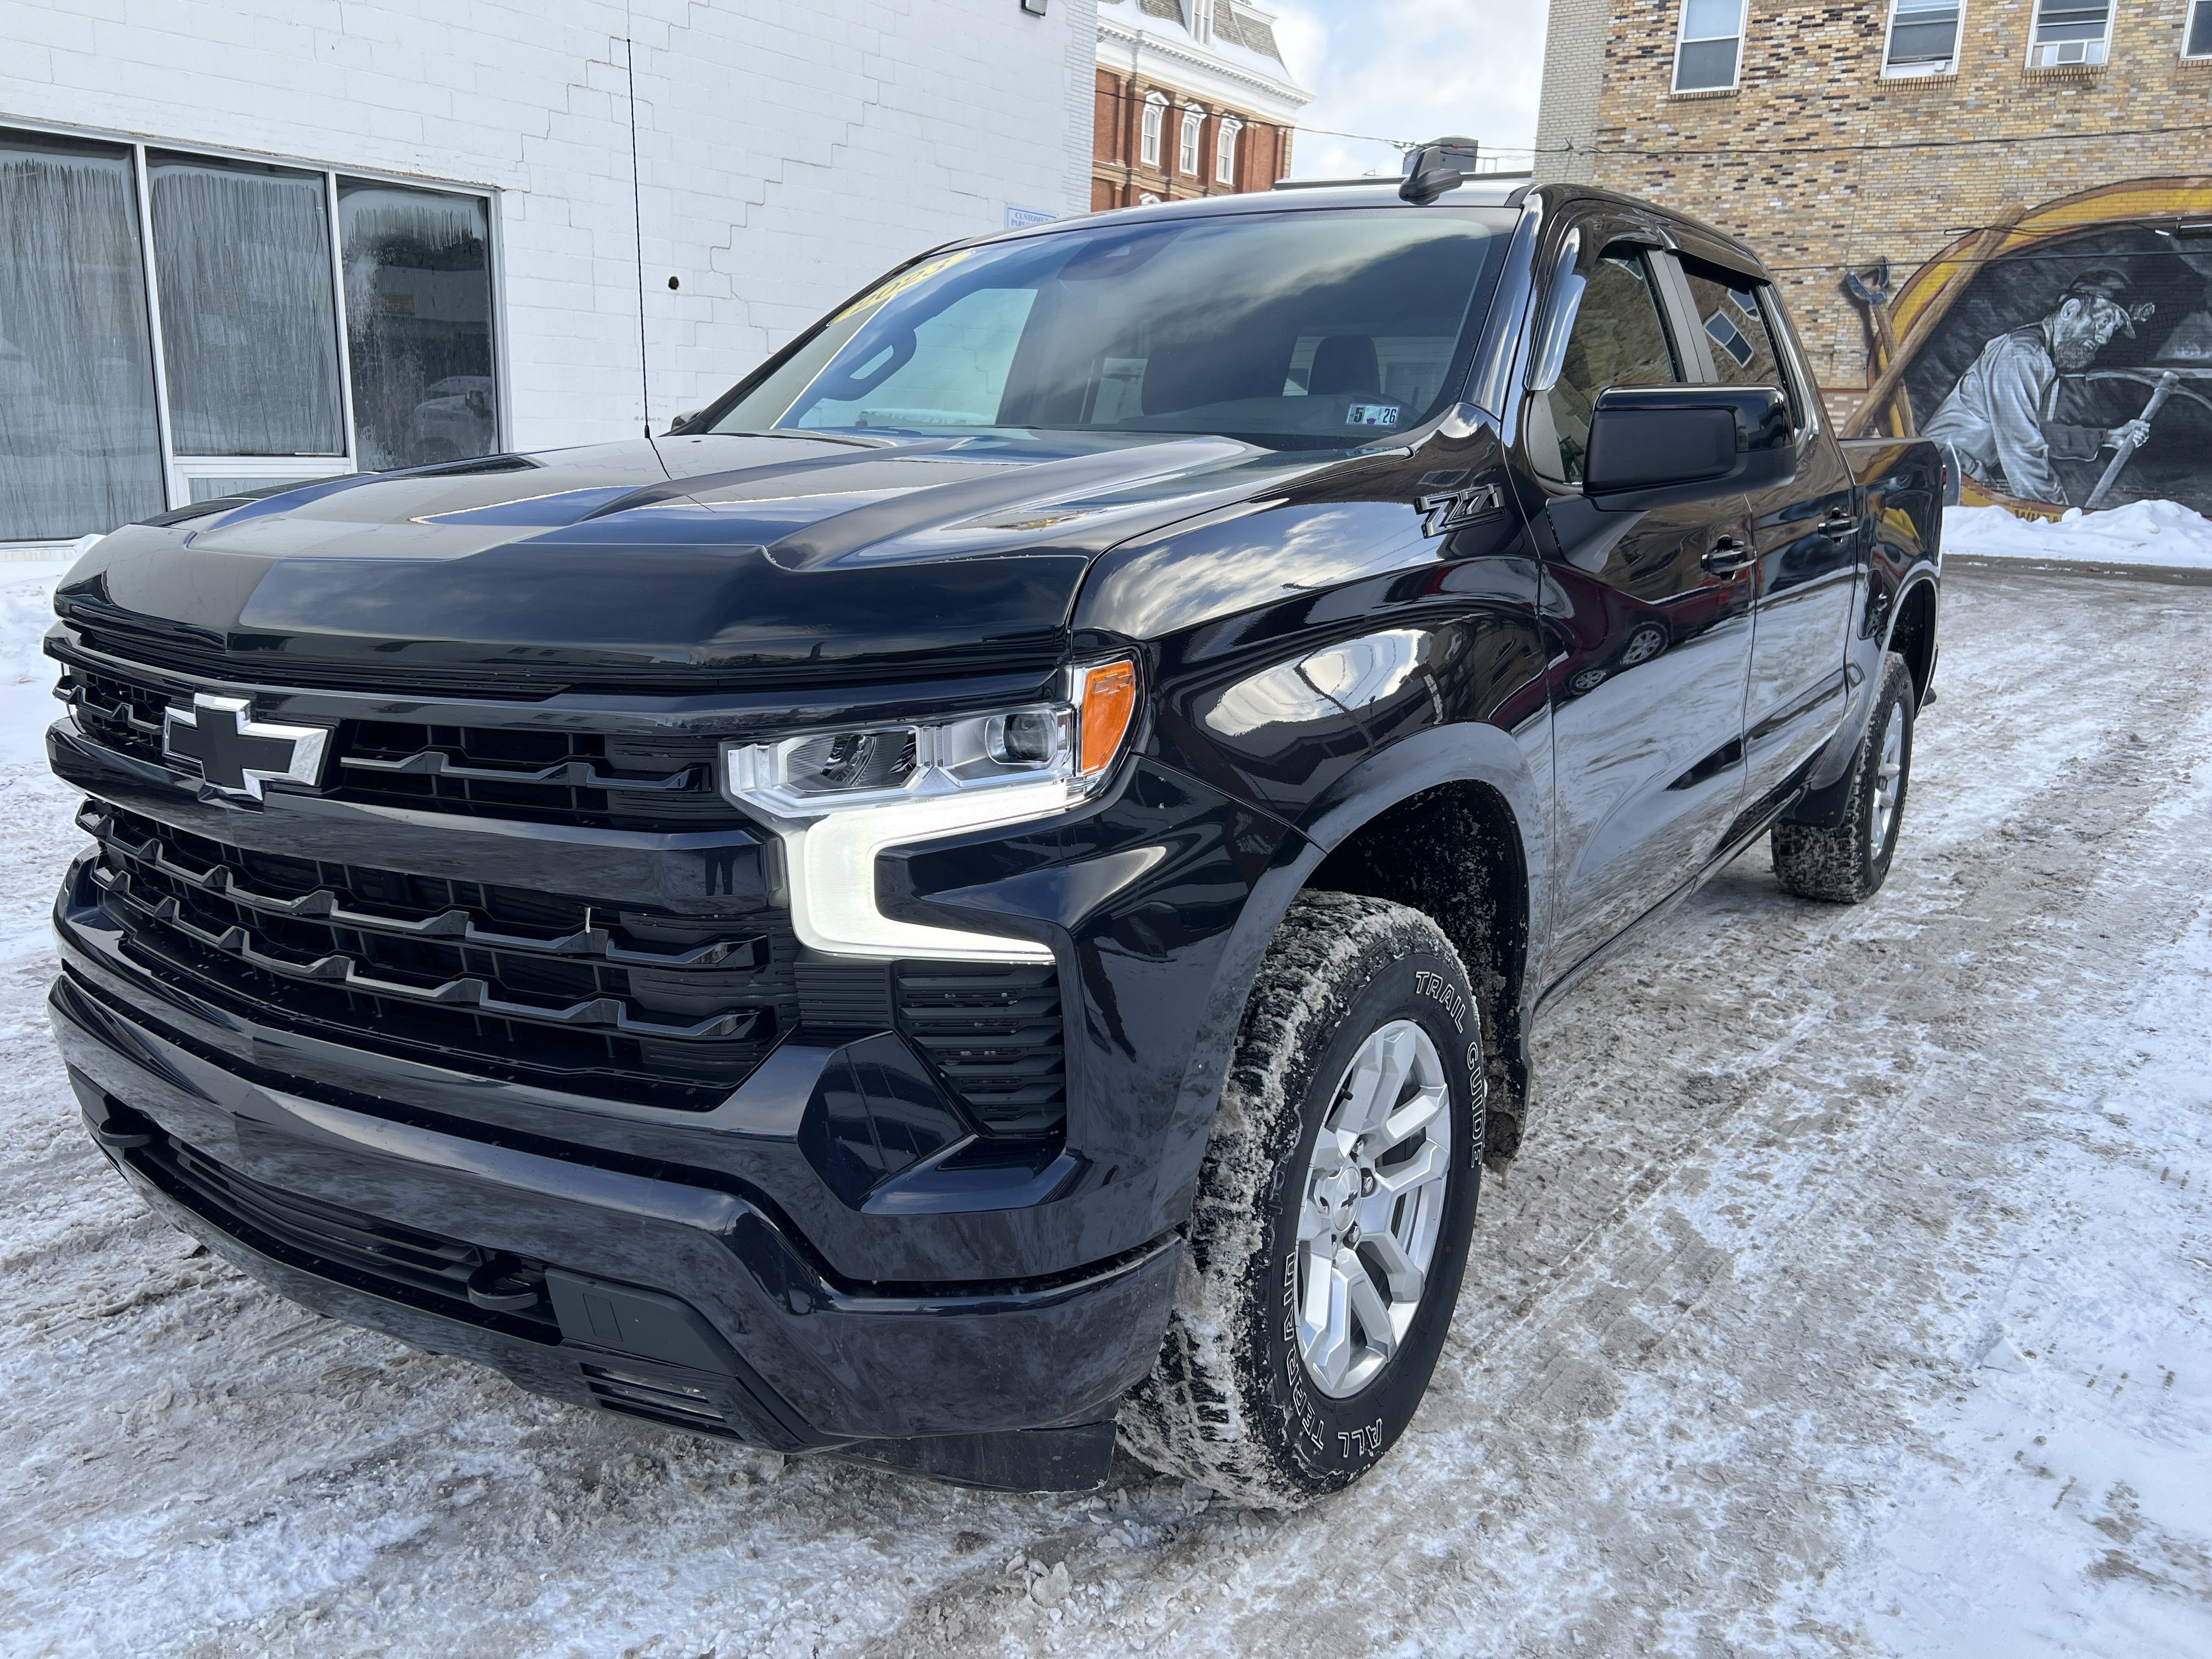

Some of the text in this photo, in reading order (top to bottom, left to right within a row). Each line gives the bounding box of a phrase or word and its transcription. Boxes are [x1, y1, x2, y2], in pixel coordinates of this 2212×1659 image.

[849, 259, 951, 316] 2023
[1353, 407, 1397, 424] 5 26
[1415, 971, 1483, 1169] TRAIL GUIDE
[1283, 1250, 1383, 1458] ALL TERRAIN
